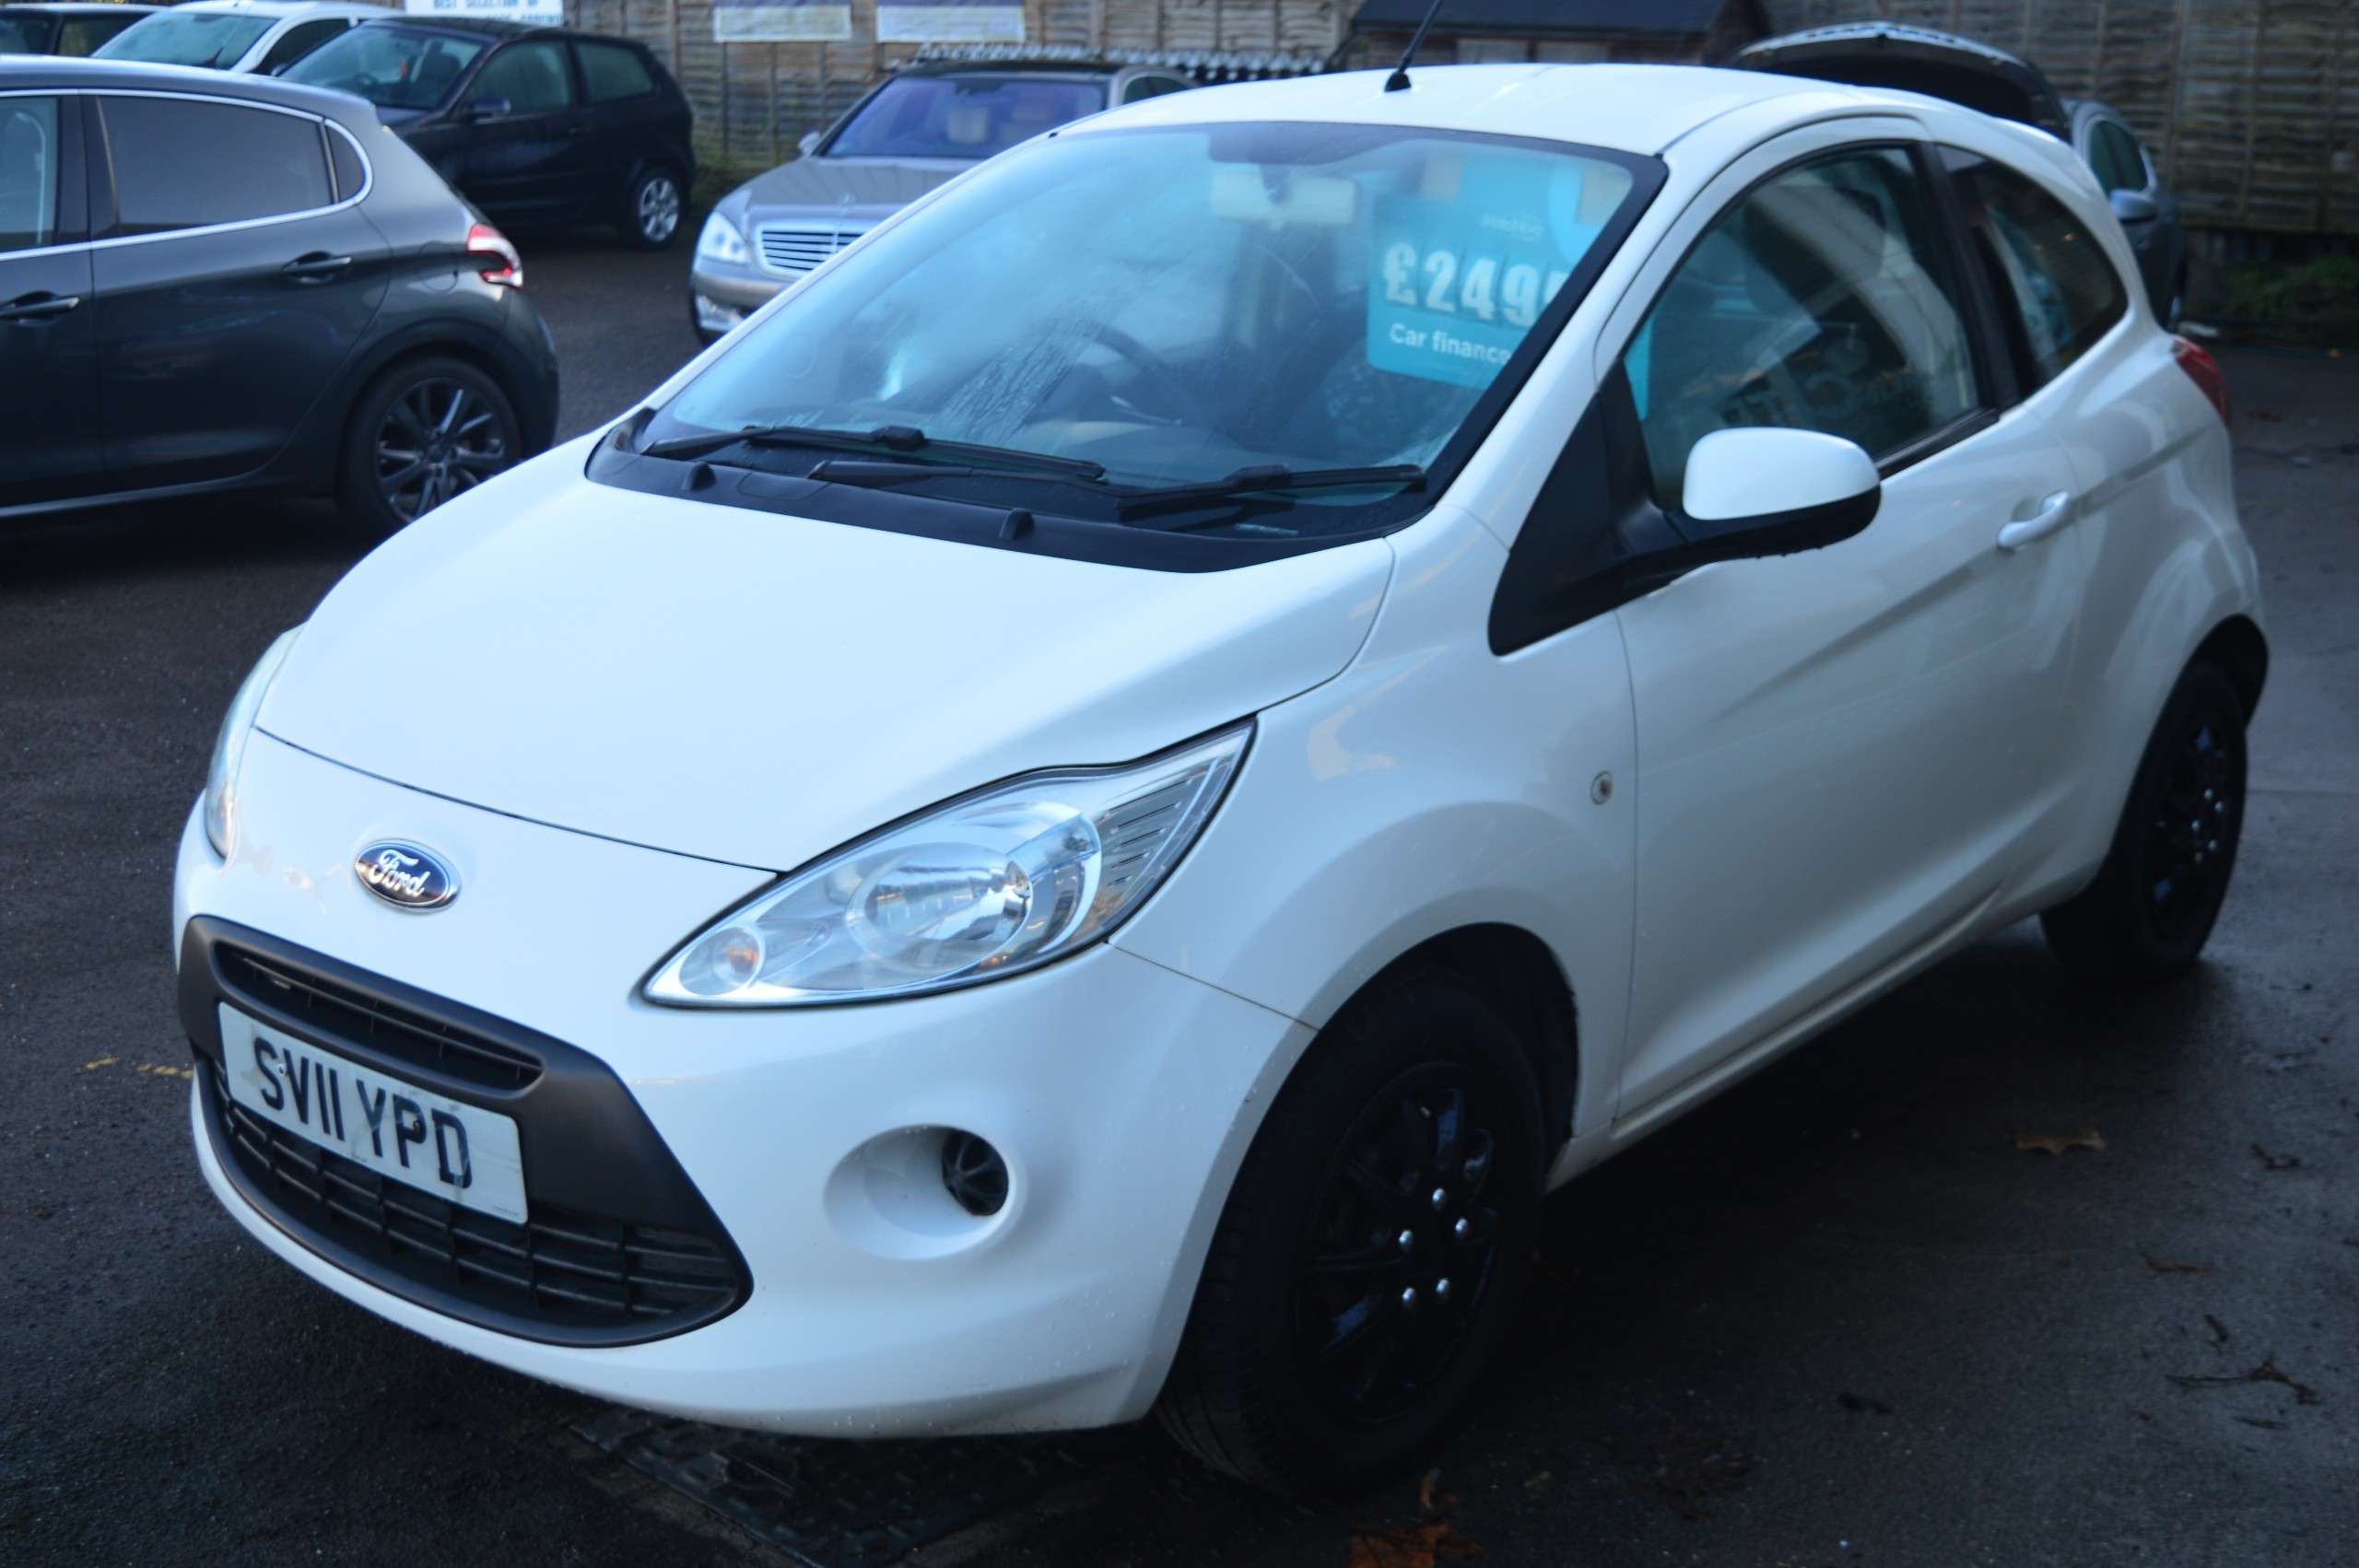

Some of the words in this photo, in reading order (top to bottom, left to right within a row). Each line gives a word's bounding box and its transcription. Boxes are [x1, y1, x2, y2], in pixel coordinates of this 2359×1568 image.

[1389, 322, 1426, 348] Car
[368, 848, 431, 897] Ford
[253, 1036, 346, 1142] SV11
[356, 1078, 474, 1190] YPD
